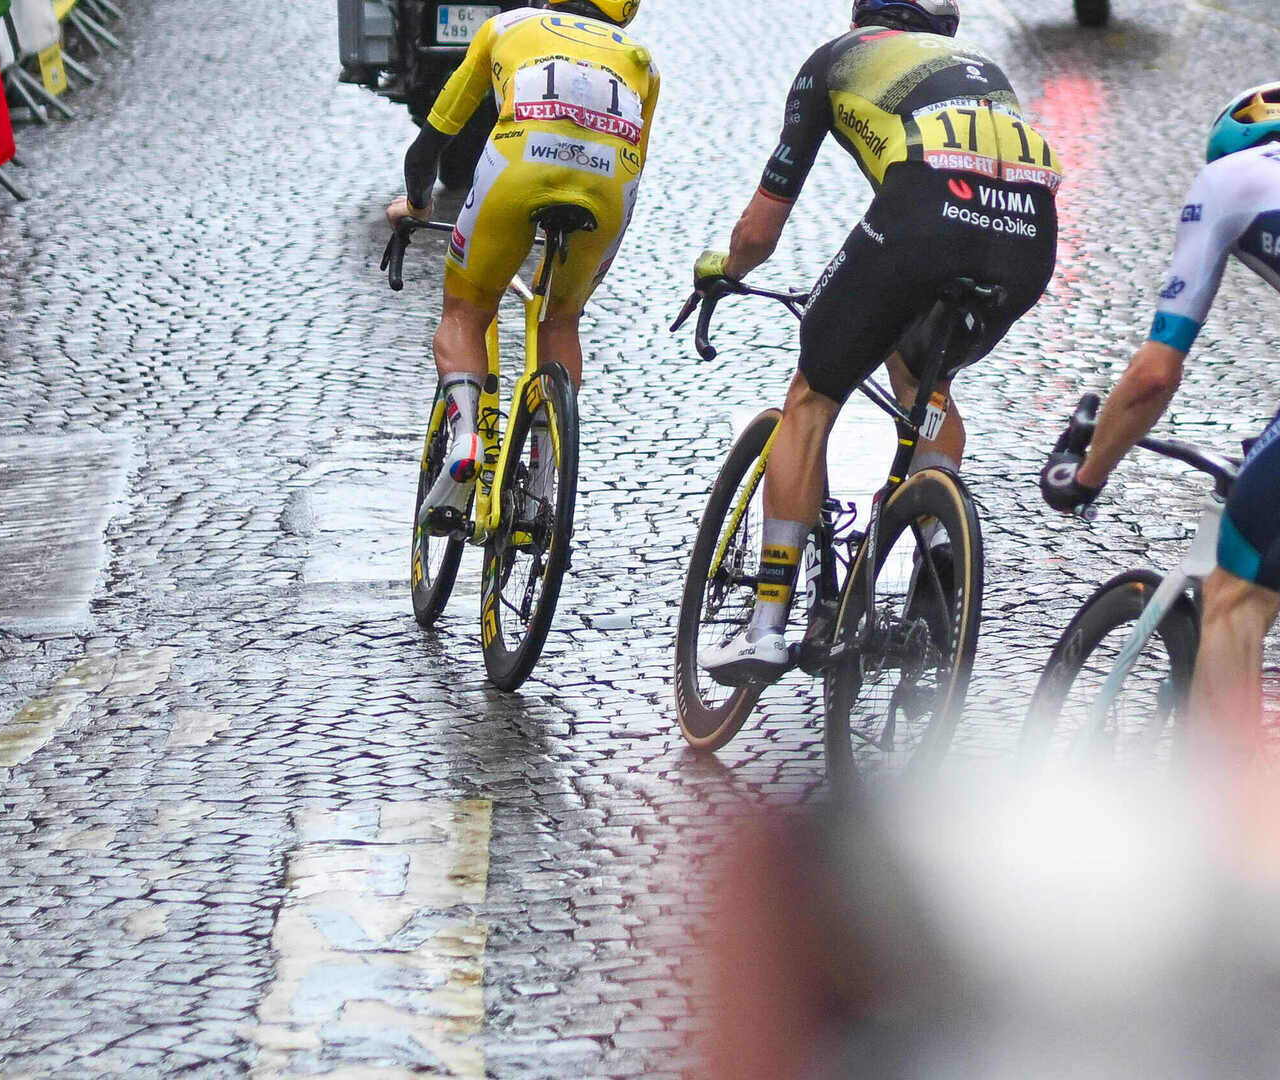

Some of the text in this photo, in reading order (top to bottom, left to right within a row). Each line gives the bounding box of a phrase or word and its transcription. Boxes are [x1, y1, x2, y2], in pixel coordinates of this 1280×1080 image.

[442, 24, 468, 37] 489
[542, 61, 623, 117] 1 1
[927, 102, 949, 112] VAN
[517, 103, 640, 142] VELUX VELUX
[837, 103, 889, 160] Rabobank
[936, 109, 978, 153] 17
[531, 143, 610, 172] WHOOSH
[927, 153, 995, 173] BASIC-FIT
[978, 185, 1036, 215] VISMA
[942, 201, 990, 231] lease
